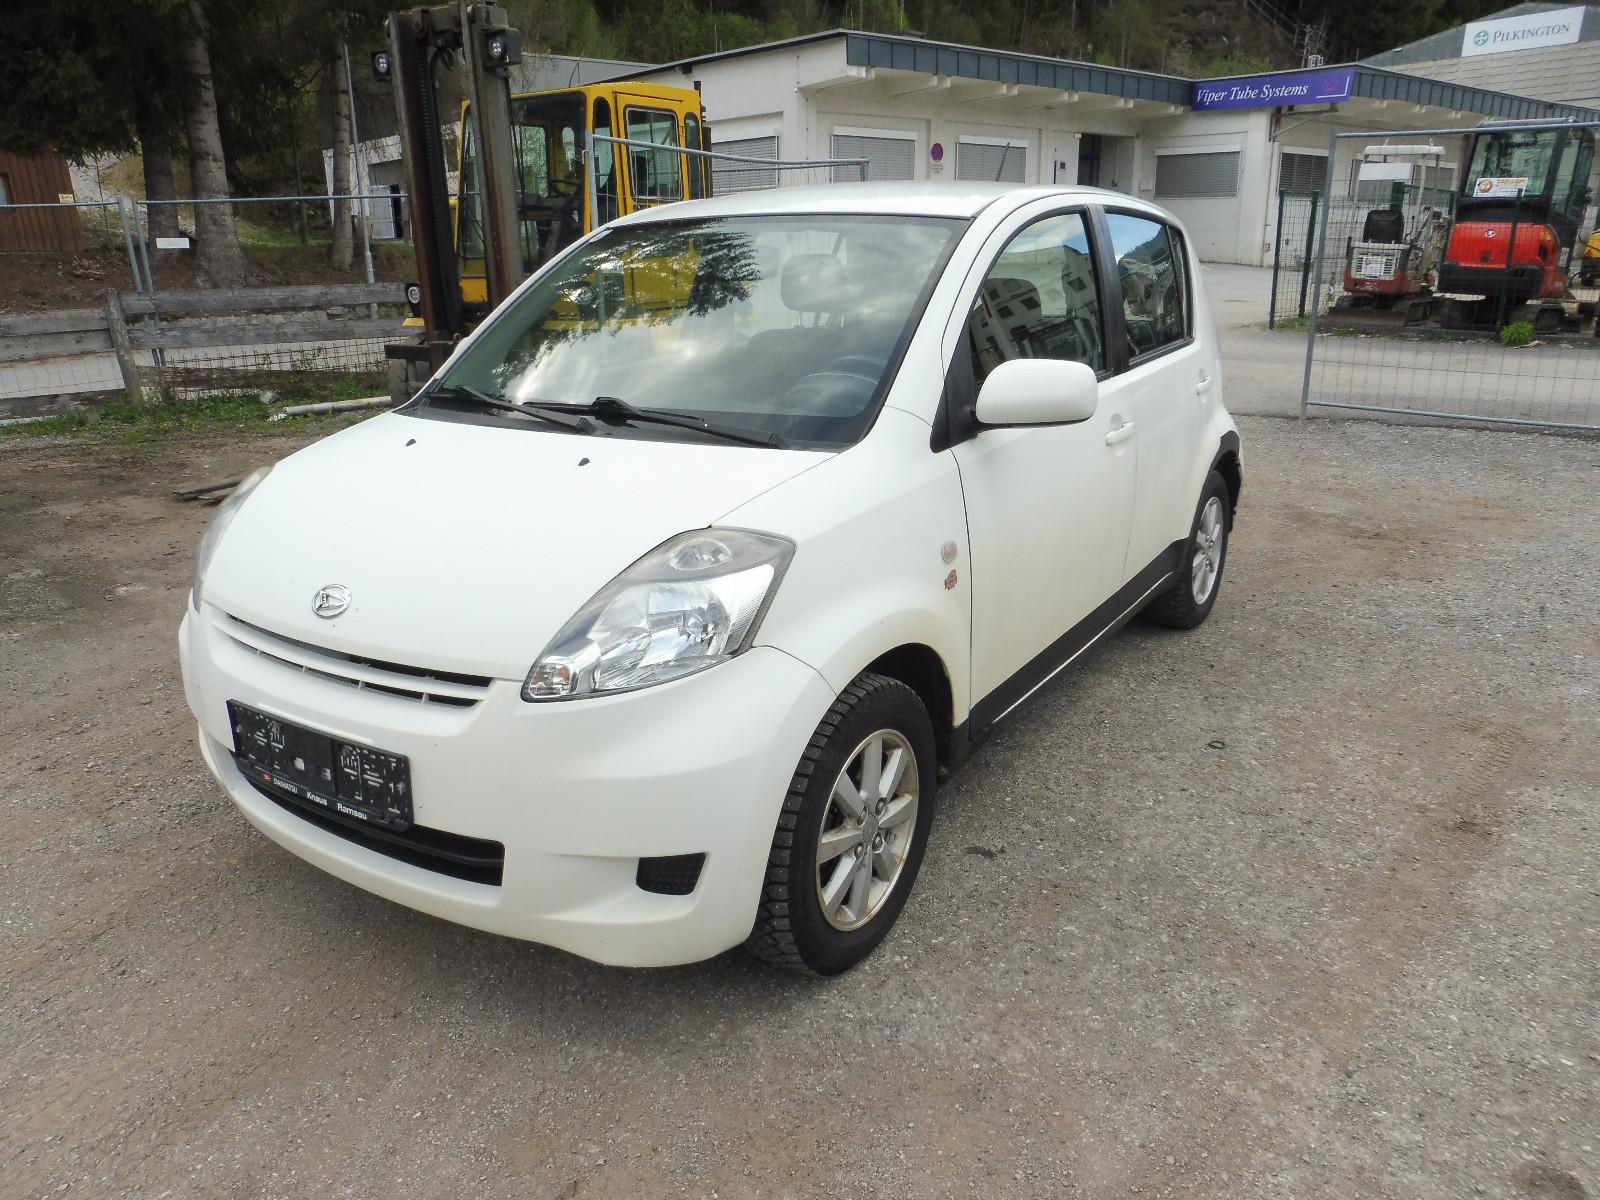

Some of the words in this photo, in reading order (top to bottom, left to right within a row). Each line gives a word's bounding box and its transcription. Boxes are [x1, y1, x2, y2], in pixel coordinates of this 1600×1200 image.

[1493, 24, 1570, 43] PILKINGTON
[1197, 89, 1227, 105] Viper
[1230, 86, 1259, 101] Tube
[1260, 84, 1309, 101] Systems
[273, 777, 298, 794] DAIHATSU
[306, 791, 328, 806] Knaus
[337, 802, 368, 820] Ramsau
